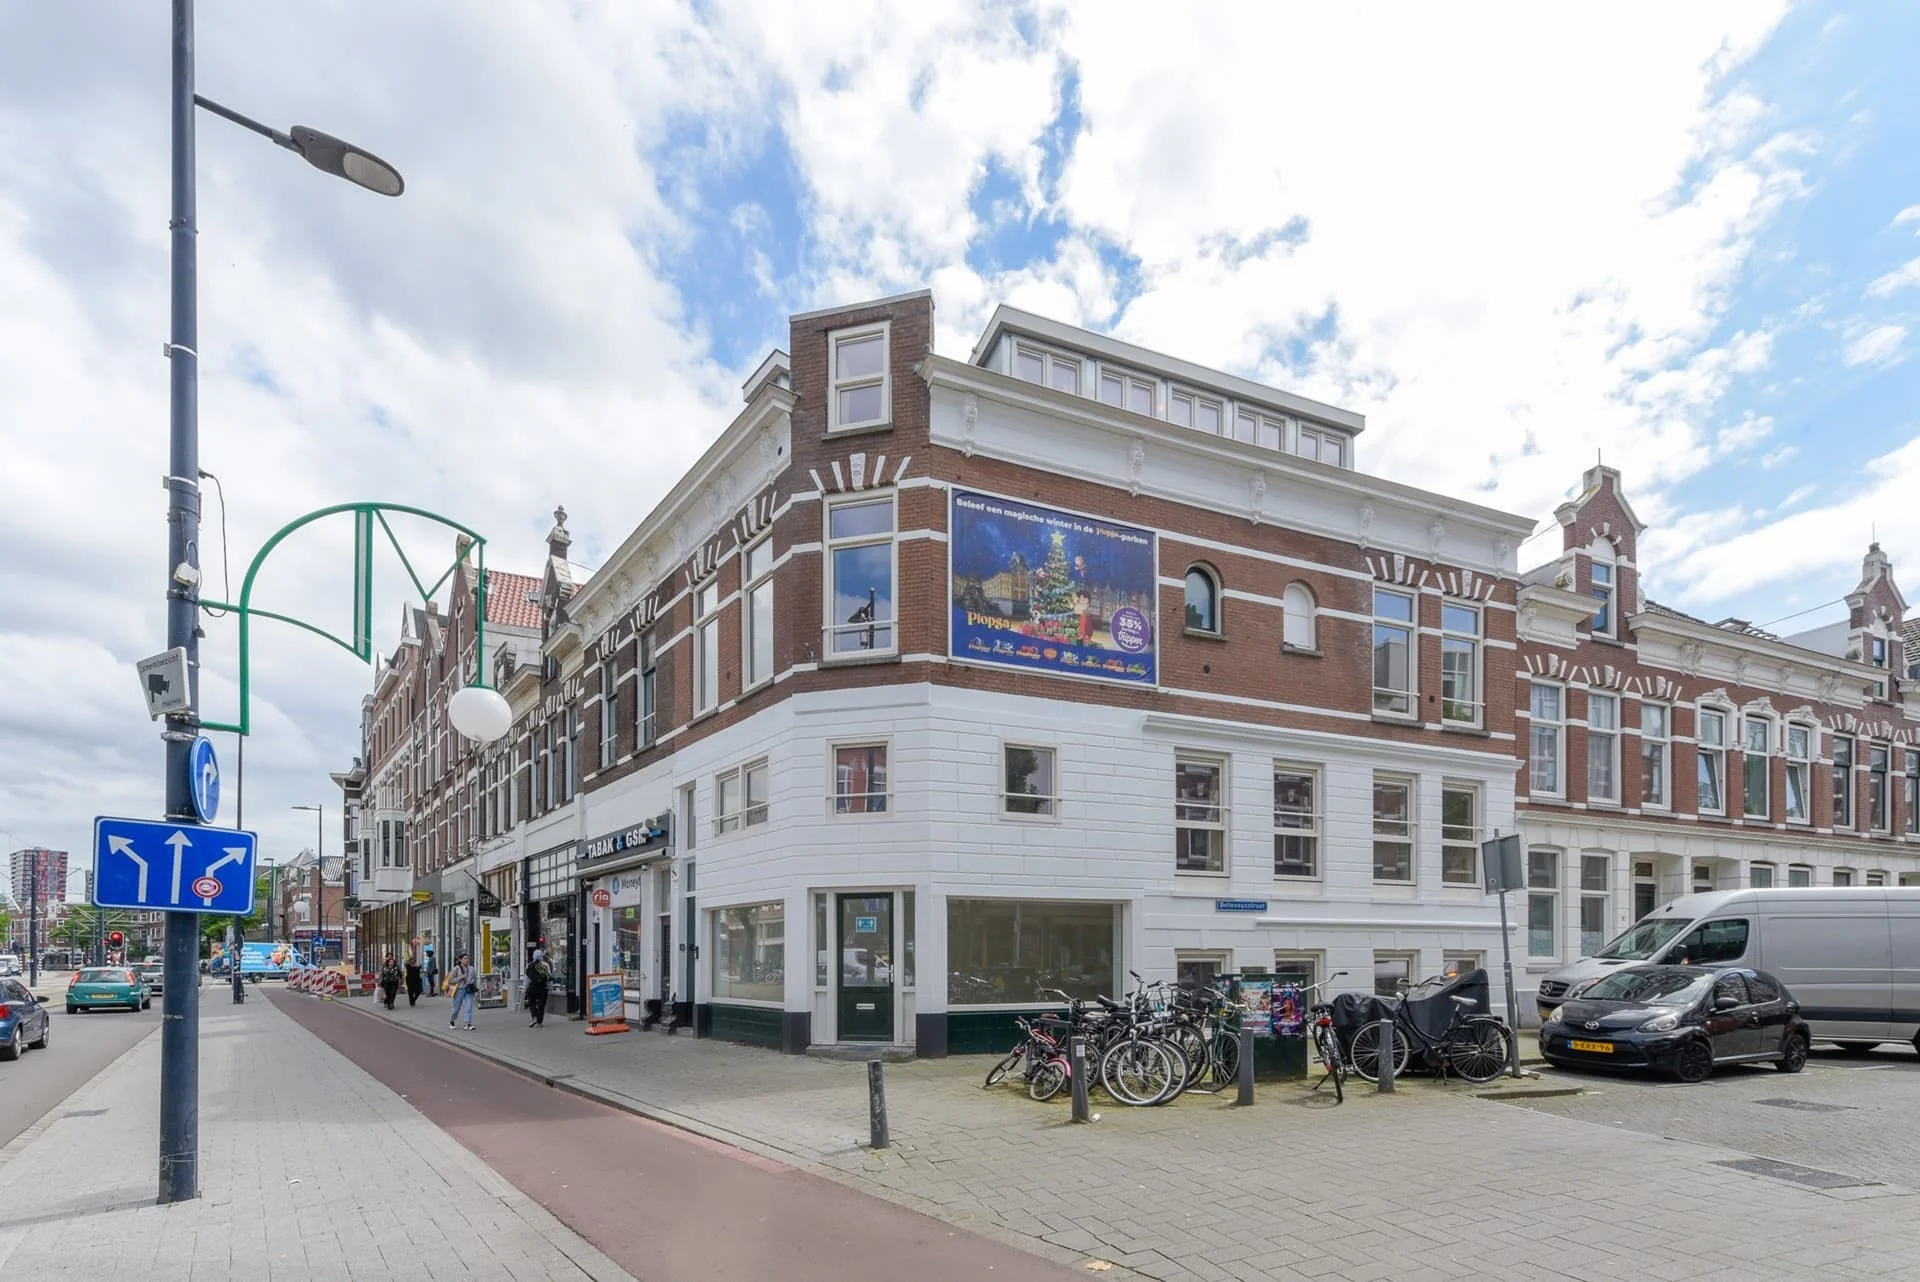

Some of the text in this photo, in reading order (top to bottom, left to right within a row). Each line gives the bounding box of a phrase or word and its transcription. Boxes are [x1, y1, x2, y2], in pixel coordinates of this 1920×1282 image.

[956, 498, 985, 511] Beleef
[986, 505, 1002, 515] een
[1004, 509, 1045, 524] magische
[1046, 518, 1073, 529] winter
[1073, 522, 1082, 532] in
[1083, 525, 1094, 534] de
[967, 611, 1010, 630] Plopsa
[1119, 616, 1142, 631] 35%
[587, 837, 614, 859] TABAK
[616, 832, 624, 852] &
[621, 877, 641, 890] Money
[594, 890, 609, 901] ria
